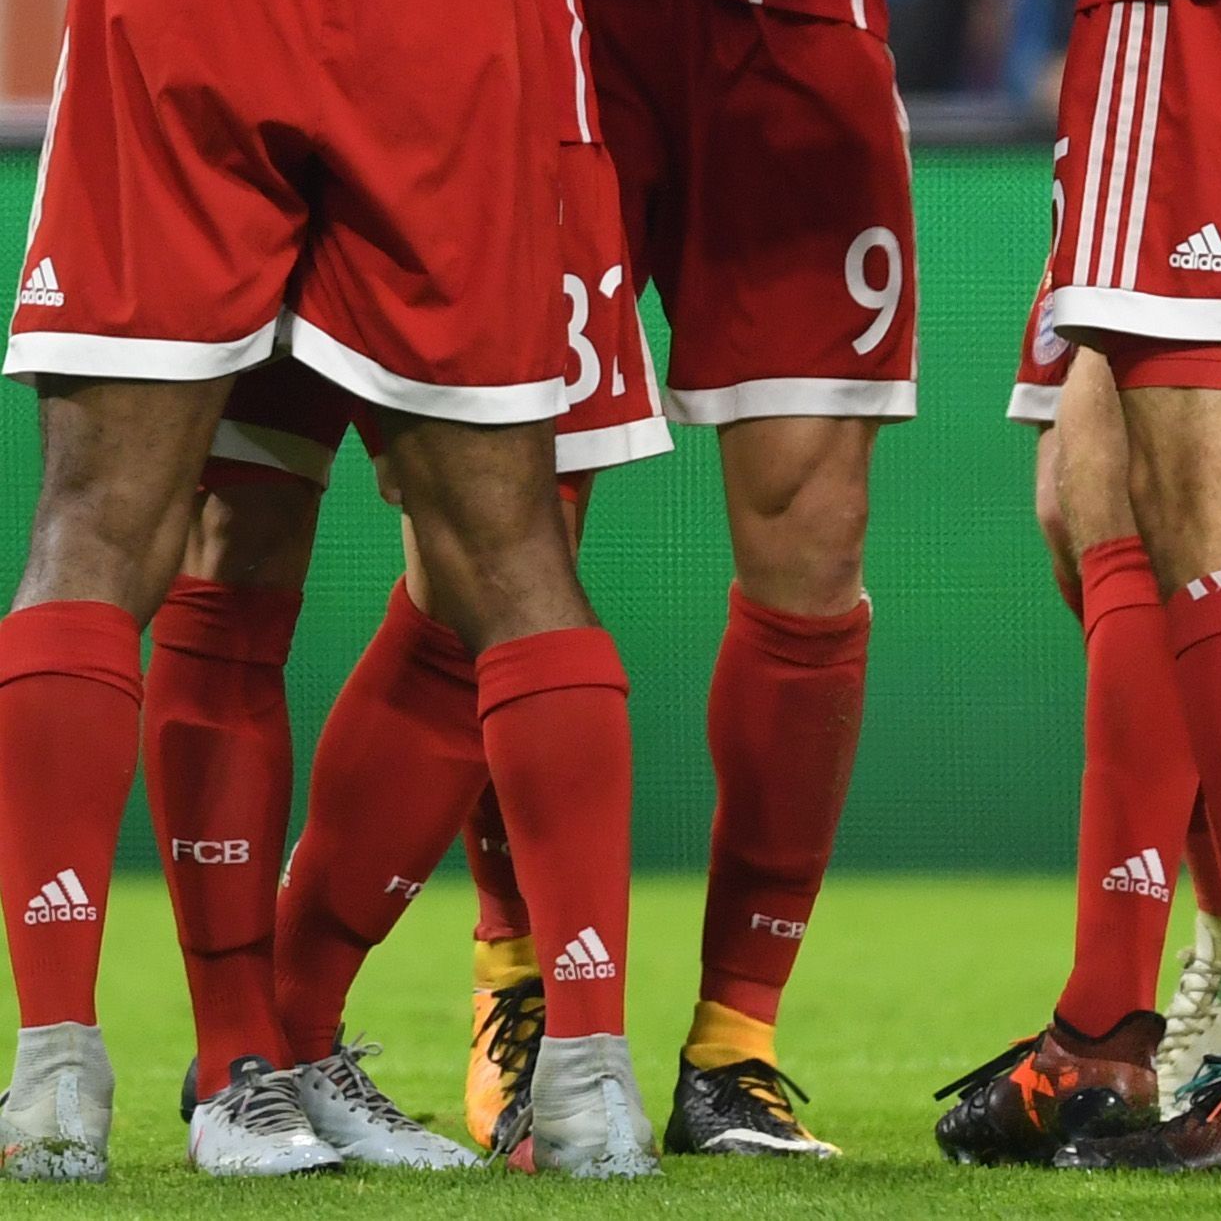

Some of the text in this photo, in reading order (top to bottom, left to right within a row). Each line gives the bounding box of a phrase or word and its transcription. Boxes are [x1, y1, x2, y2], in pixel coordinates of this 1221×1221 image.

[844, 226, 902, 356] 9
[172, 838, 250, 864] FCB
[1102, 874, 1170, 903] adidas
[24, 902, 98, 926] adidas
[751, 913, 807, 940] FCB
[554, 961, 616, 981] adidas
